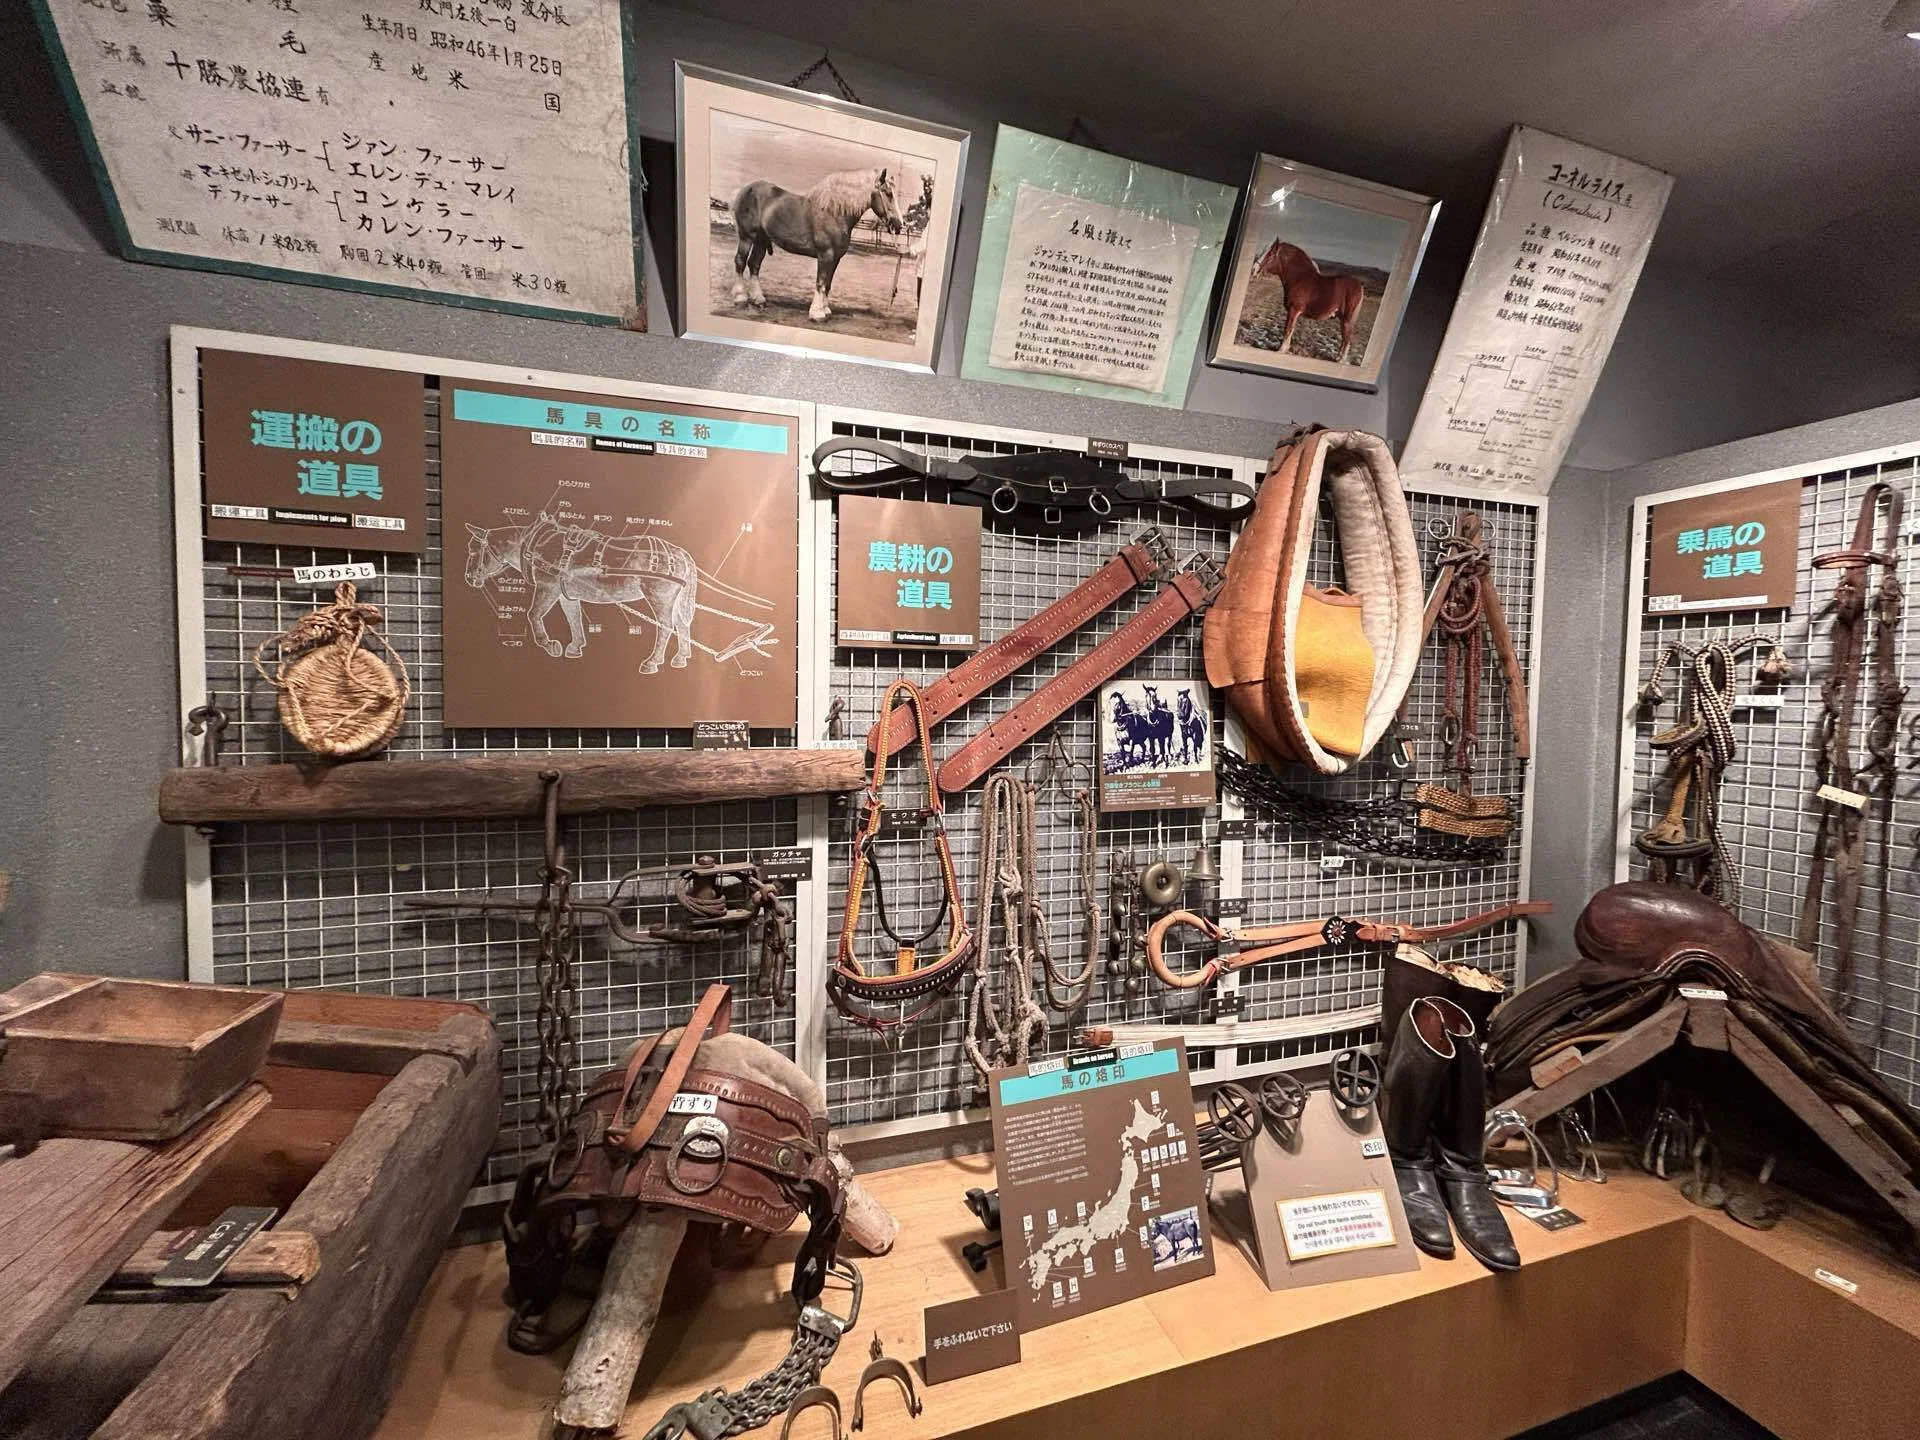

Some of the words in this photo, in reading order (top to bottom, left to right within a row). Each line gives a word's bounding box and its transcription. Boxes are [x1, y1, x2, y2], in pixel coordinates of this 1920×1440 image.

[361, 13, 418, 42] 生年月日
[429, 30, 563, 77] 昭和46年1月25日
[165, 50, 312, 102] 十勝農協連
[249, 408, 384, 457] 運搬の
[545, 405, 712, 441] 馬具の名称
[297, 458, 385, 502] 道具
[1675, 521, 1767, 555] 乗馬の
[296, 565, 372, 582] 馬のわらじ
[867, 541, 953, 575] 農耕の
[1702, 550, 1764, 580] 道具
[896, 578, 953, 611] 道具
[1061, 1065, 1126, 1090] 馬の烙印
[933, 1321, 1013, 1350] 手をふれないで下さい
